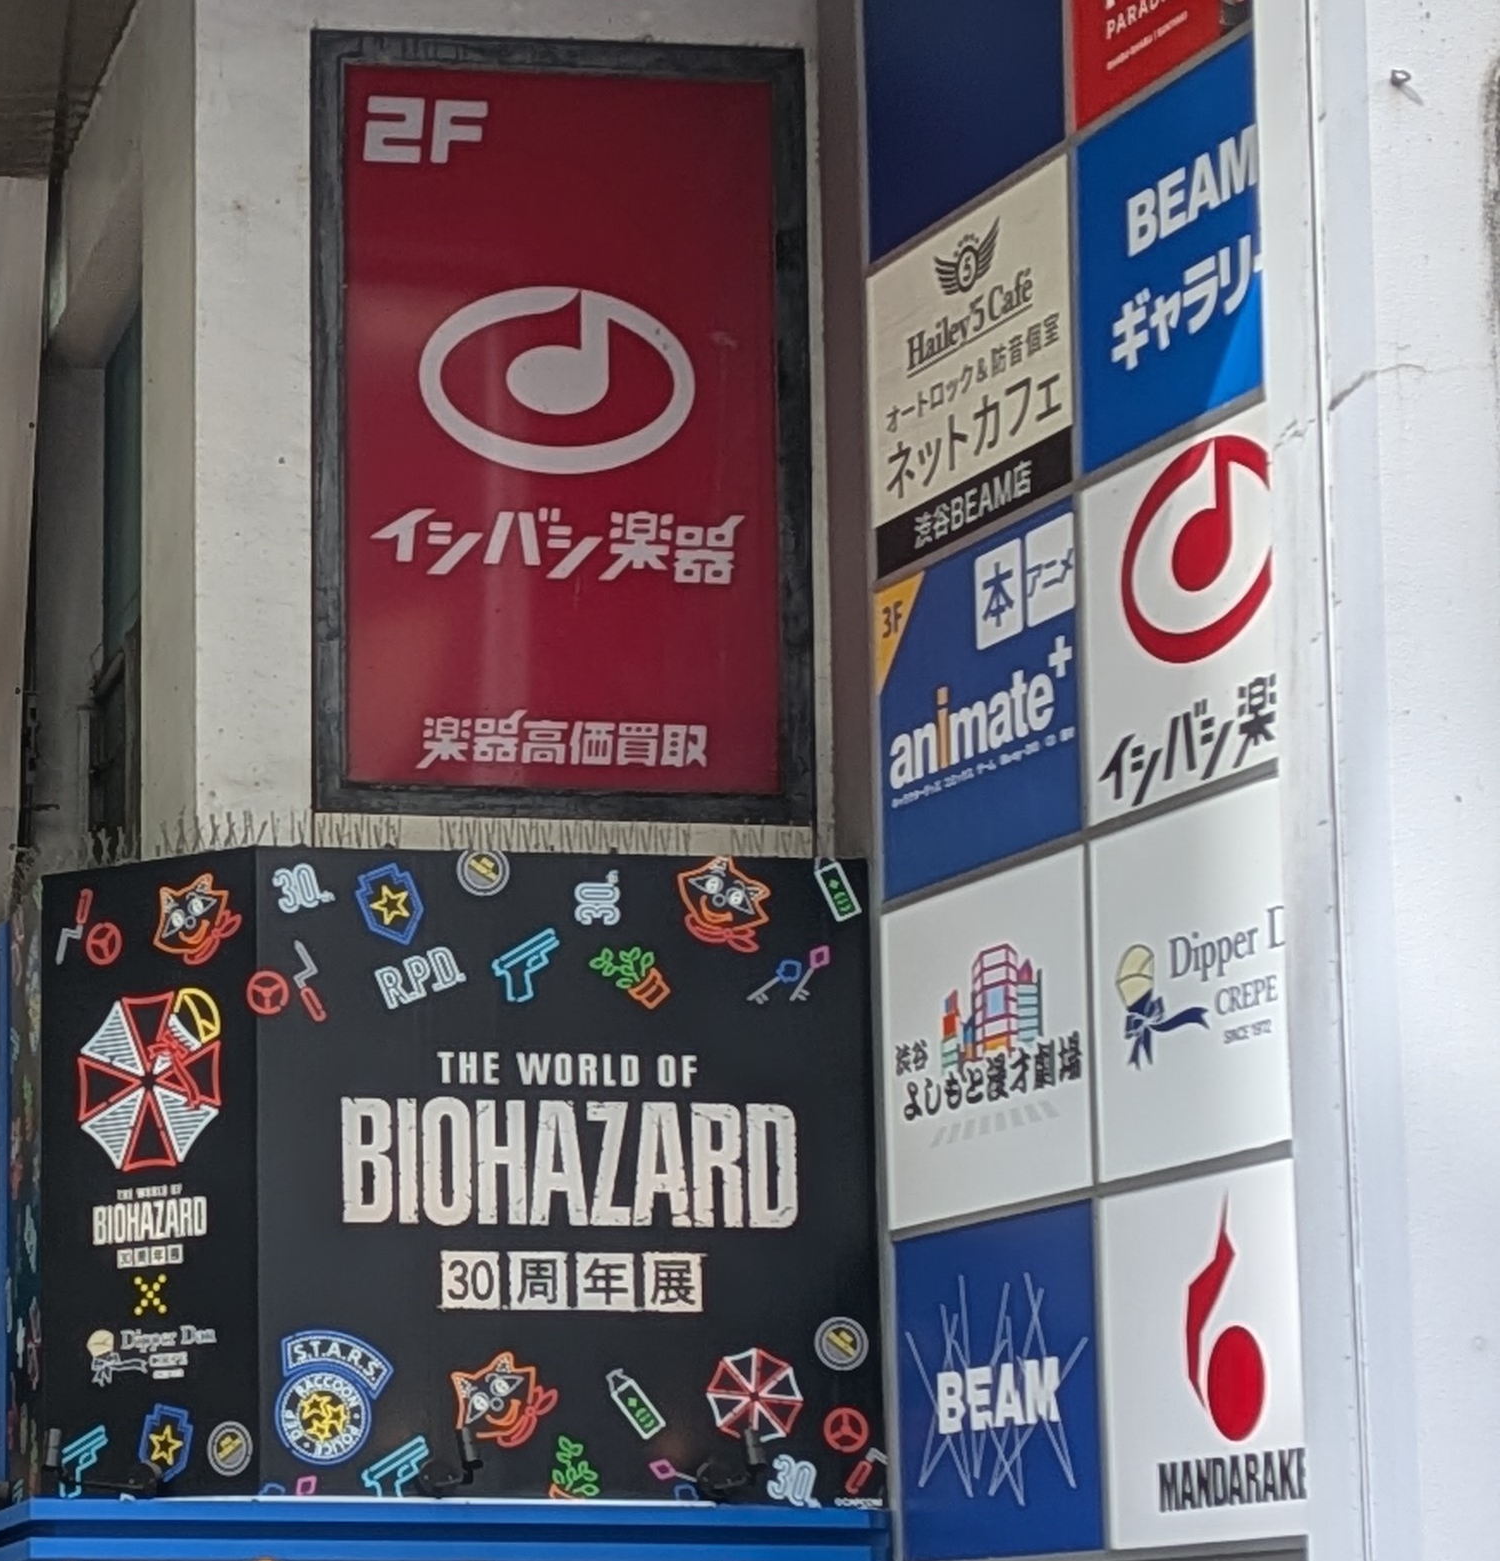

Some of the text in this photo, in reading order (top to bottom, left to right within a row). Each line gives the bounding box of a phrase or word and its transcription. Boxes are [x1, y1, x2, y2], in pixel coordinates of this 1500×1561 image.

[363, 96, 488, 163] 2F
[1128, 124, 1258, 258] BEAM
[1111, 234, 1262, 371] ギャラリ
[886, 372, 1062, 499] ネットカフェ
[914, 460, 1032, 549] 渋谷BEAM店
[371, 508, 746, 585] イシバシ楽器
[1026, 547, 1075, 598] アニメ
[881, 602, 904, 640] 3F
[982, 561, 1014, 628] 本
[415, 710, 709, 769] 楽器高価買取
[890, 669, 1055, 789] animate
[1168, 927, 1259, 982] Dipper
[1214, 974, 1279, 1015] CREPE
[895, 1039, 929, 1076] 渋谷
[1223, 1025, 1250, 1044] SINCE
[438, 1051, 699, 1088] THE WORLD OF
[904, 1031, 1083, 1121] よしもと漫才劇場
[340, 1096, 799, 1229] BIOHAZARD
[92, 1196, 208, 1246] BIOHAZARD
[442, 1254, 701, 1309] 30周年展
[120, 1324, 217, 1353] Dipper Dan
[293, 1340, 380, 1382] S.T.A.R.S.
[295, 1375, 361, 1408] RACCOON
[937, 1356, 1061, 1435] BEAM
[1158, 1447, 1307, 1513] MANDARAKE
